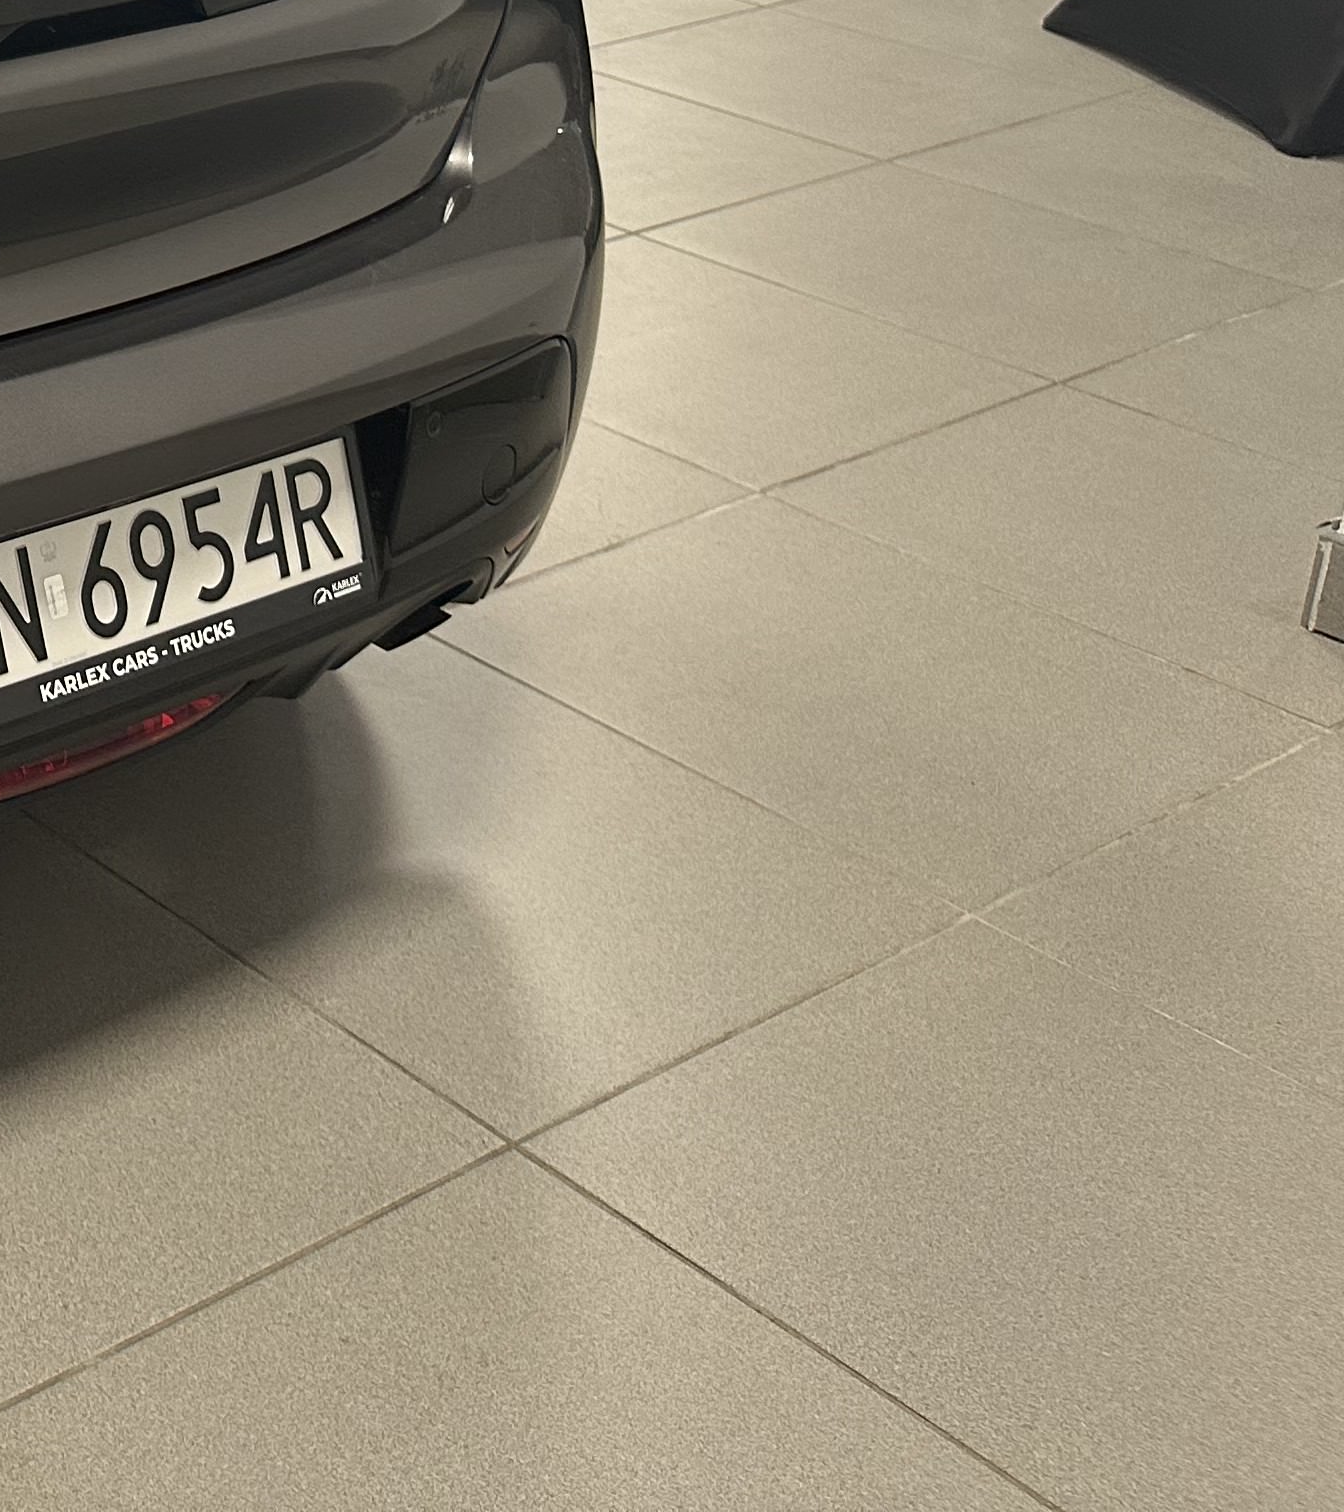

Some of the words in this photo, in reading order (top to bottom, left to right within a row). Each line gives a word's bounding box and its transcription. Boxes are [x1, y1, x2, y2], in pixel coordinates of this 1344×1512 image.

[81, 457, 344, 639] 6954R
[331, 574, 360, 592] KARLEX
[39, 662, 111, 702] KARLEX
[112, 646, 159, 677] CARS
[169, 619, 236, 657] TRUCKS
